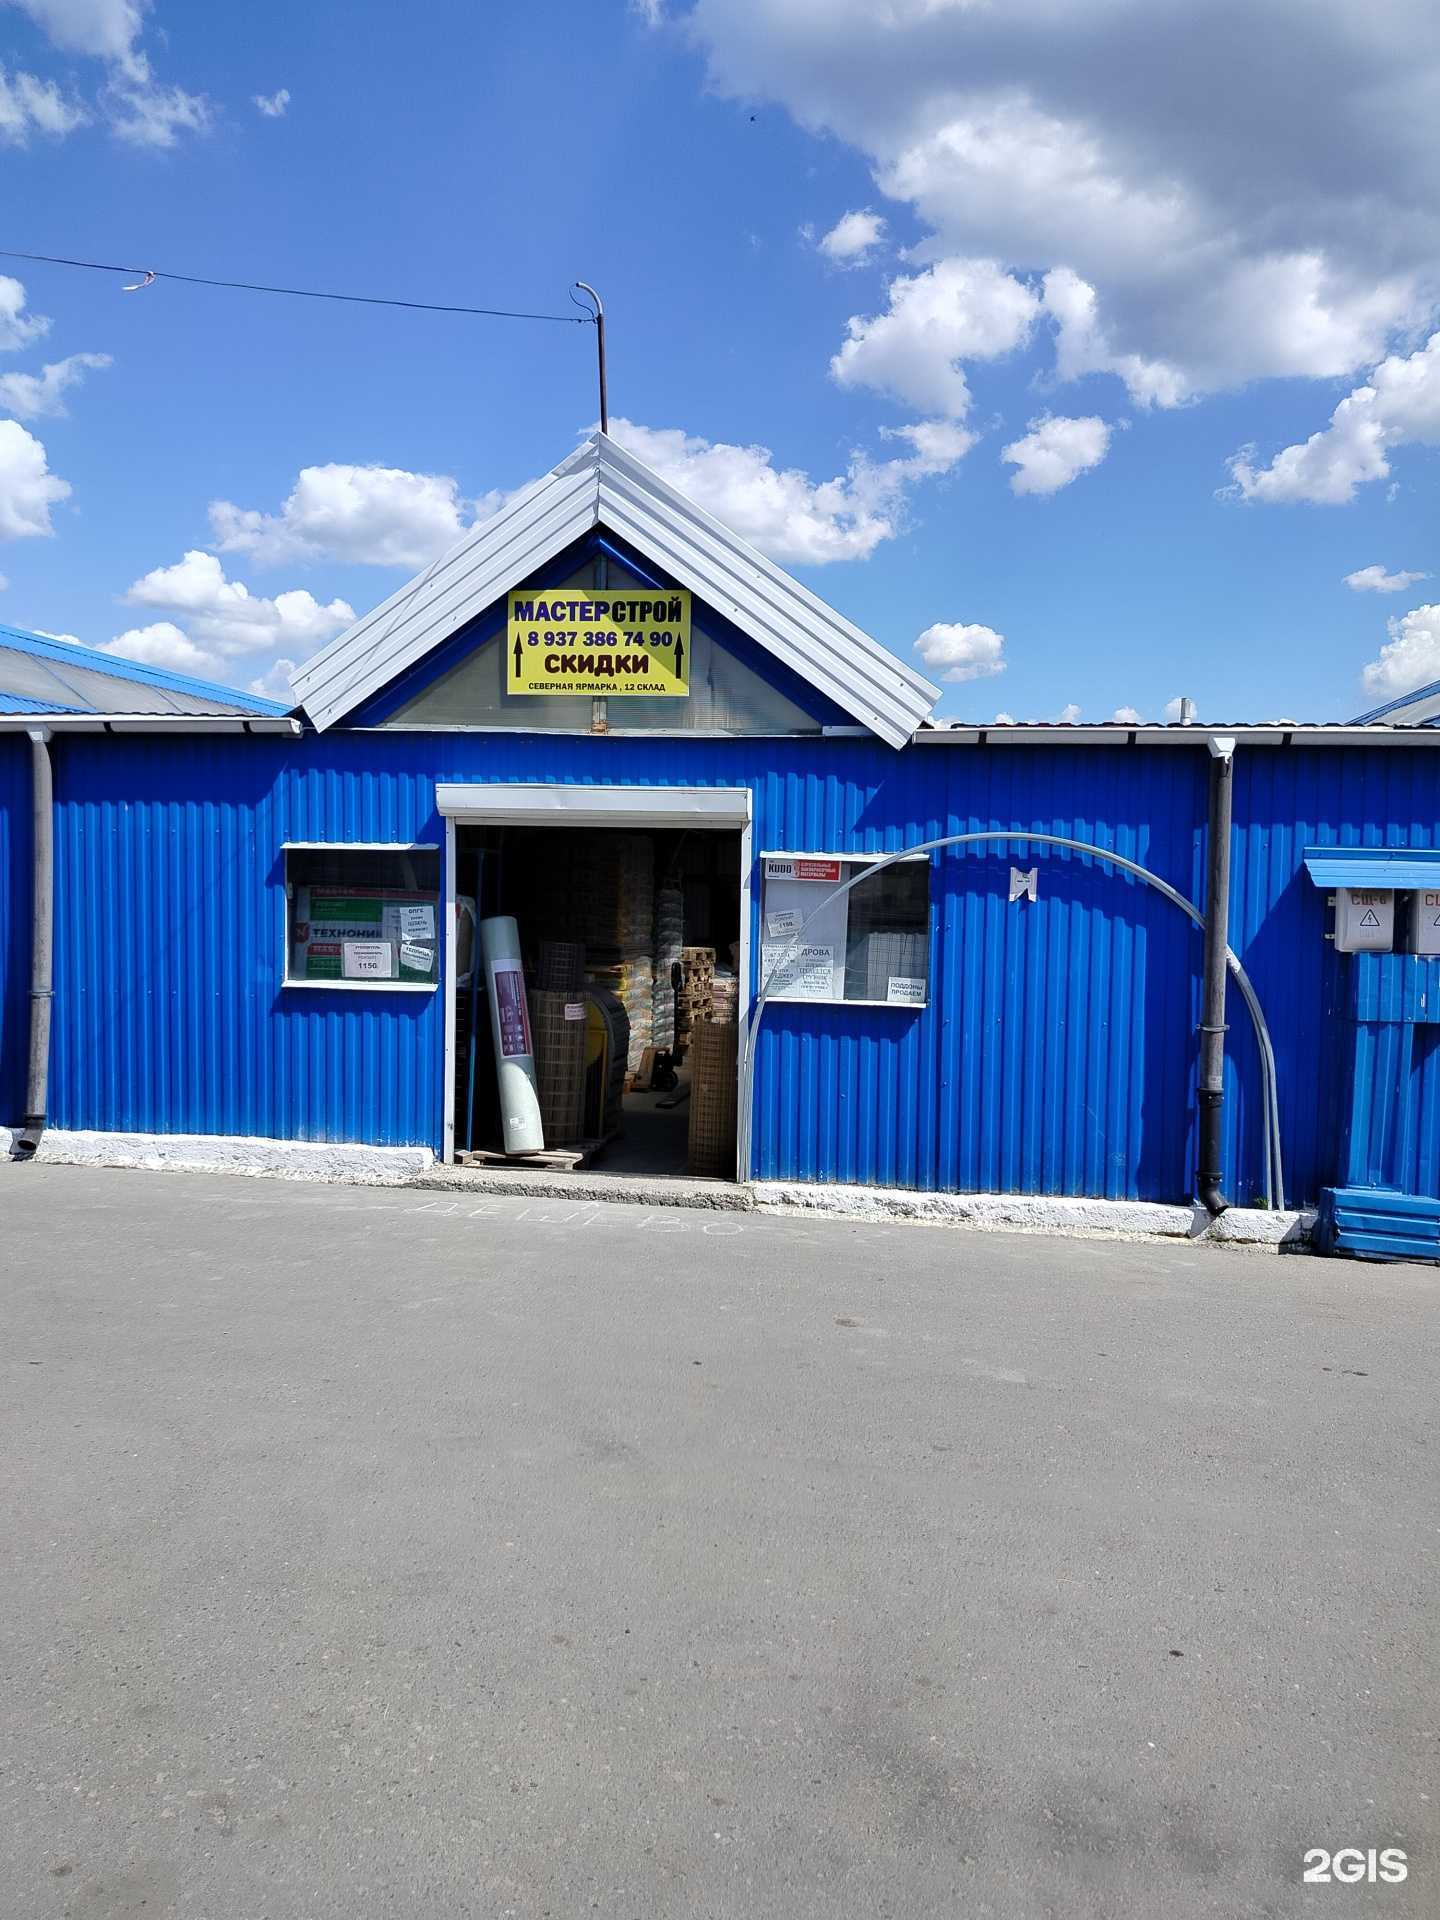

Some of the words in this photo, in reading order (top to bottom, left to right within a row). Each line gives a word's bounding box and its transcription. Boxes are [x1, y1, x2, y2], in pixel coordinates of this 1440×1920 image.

[514, 596, 682, 622] МАСТЕРСТРОЙ
[527, 631, 539, 647] 8
[544, 631, 578, 647] 937
[583, 631, 618, 647] 386
[623, 631, 645, 647] 74
[650, 631, 673, 647] 90
[544, 653, 649, 677] СКИДКИ
[528, 682, 574, 691] СЕВЕРНАЯ
[575, 682, 617, 691] ЯРМАРКА
[624, 683, 635, 691] 12
[636, 683, 666, 692] СКЛАД
[801, 948, 830, 957] ДРОВА
[358, 962, 377, 970] 1150
